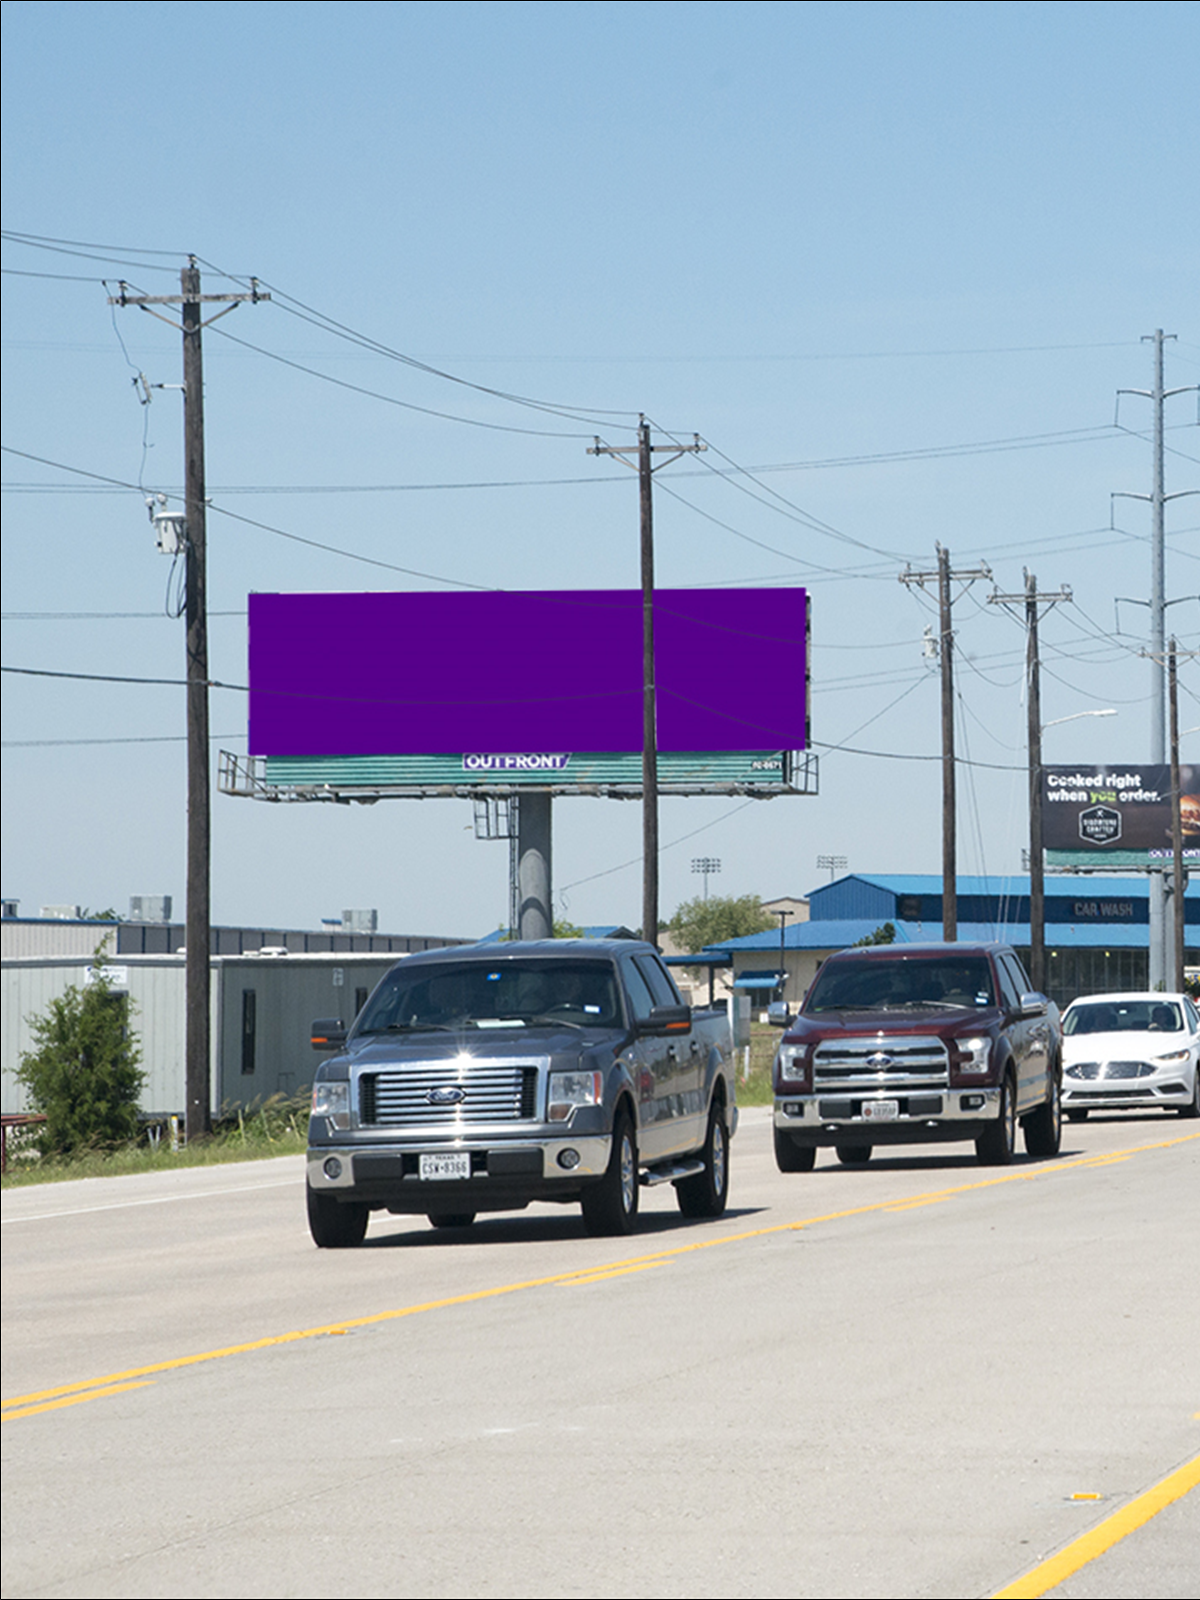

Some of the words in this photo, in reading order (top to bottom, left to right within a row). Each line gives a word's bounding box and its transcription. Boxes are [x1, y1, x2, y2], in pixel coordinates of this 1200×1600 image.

[465, 753, 567, 769] OUTFRONT
[1047, 773, 1103, 787] Cooked
[1105, 773, 1142, 789] right
[1047, 788, 1088, 802] when
[1090, 790, 1117, 804] you
[1118, 788, 1162, 802] order.
[1074, 902, 1098, 917] CAR
[1100, 902, 1134, 917] WASH
